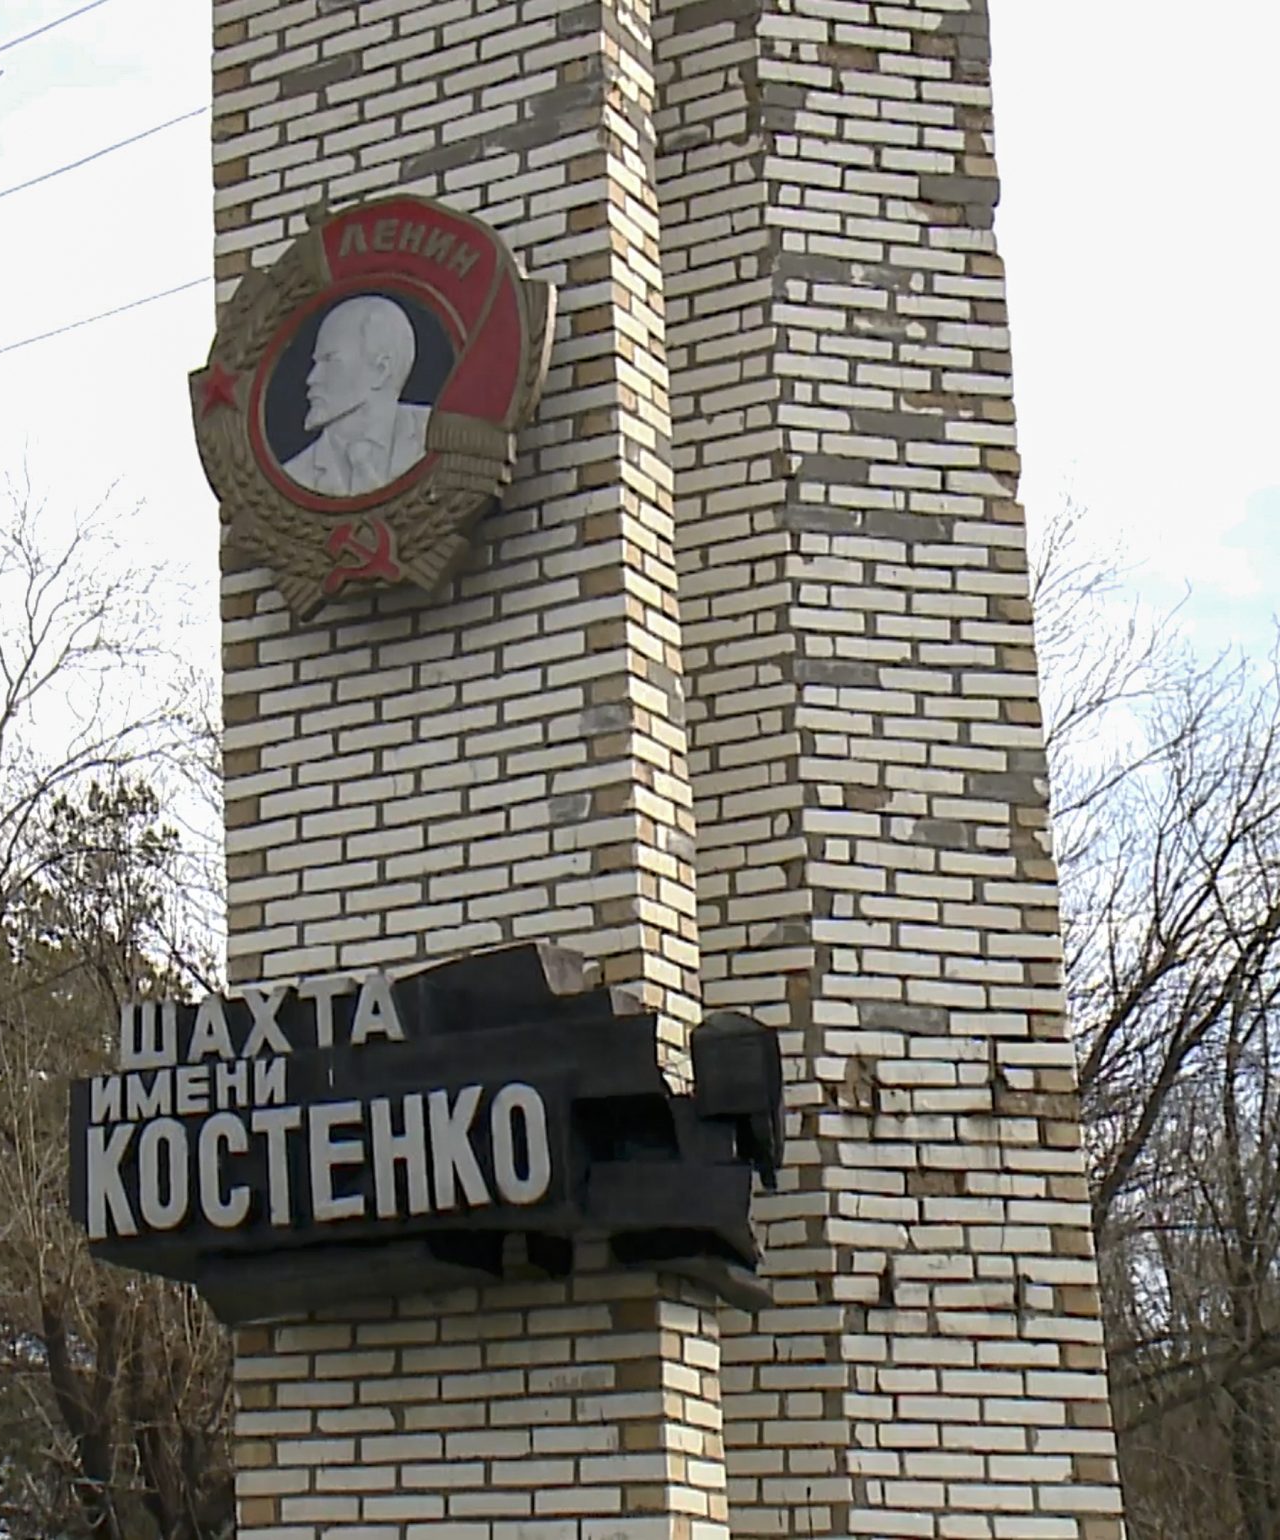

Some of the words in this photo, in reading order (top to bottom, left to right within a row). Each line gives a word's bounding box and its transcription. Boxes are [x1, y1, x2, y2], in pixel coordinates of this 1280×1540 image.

[340, 219, 479, 278] ЛЕНИН
[123, 975, 405, 1069] ШАХТА
[91, 1058, 286, 1123] ИМЕНИ
[87, 1083, 551, 1239] КОСТЕНКО
